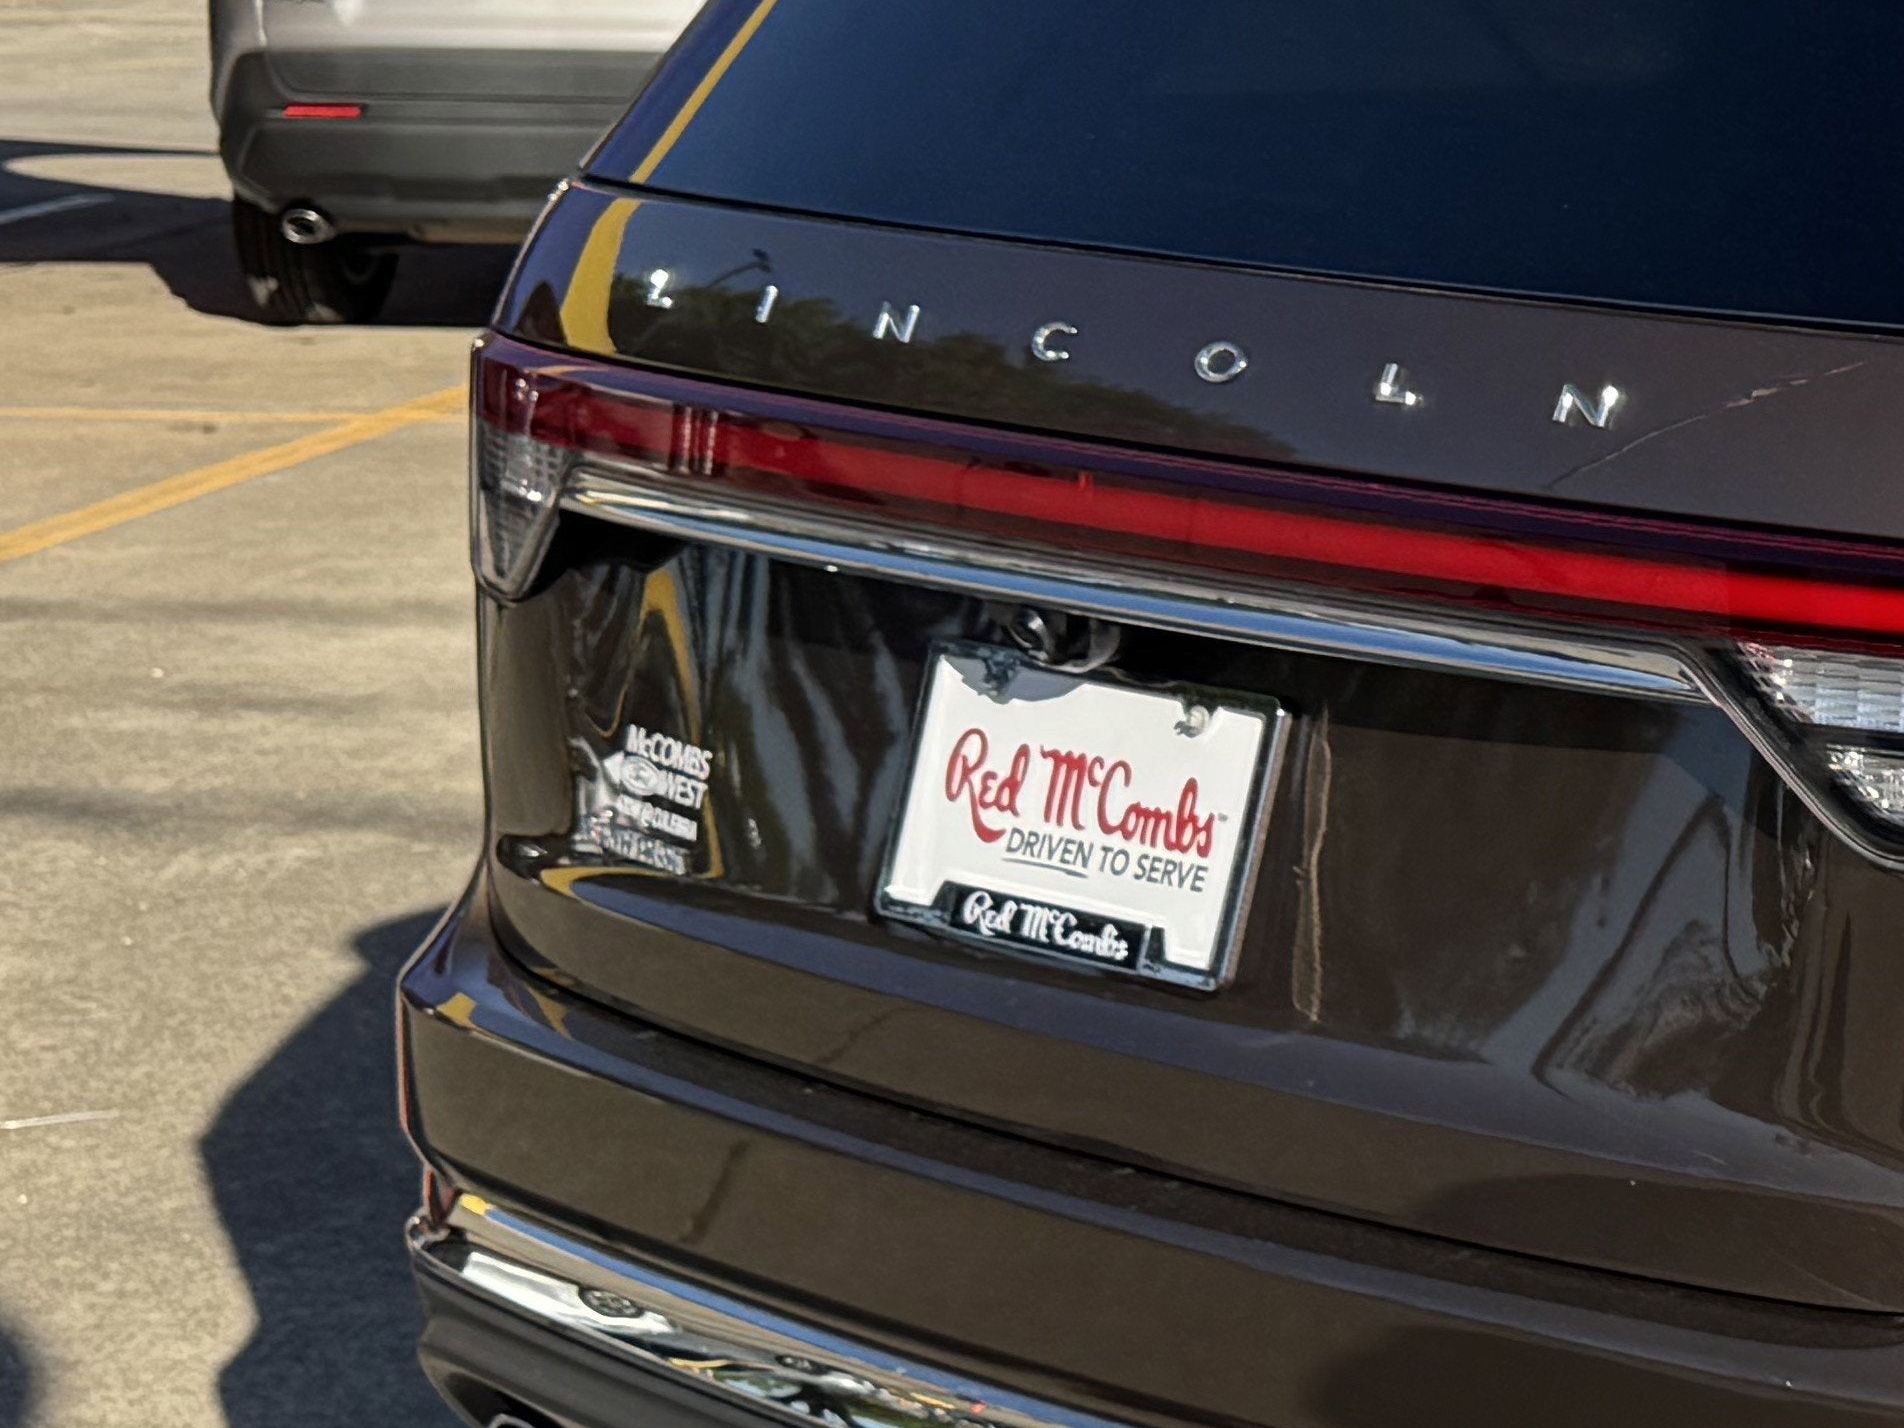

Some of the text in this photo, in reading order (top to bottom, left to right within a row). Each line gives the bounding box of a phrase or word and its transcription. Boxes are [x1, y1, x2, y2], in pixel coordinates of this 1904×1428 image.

[645, 268, 1621, 429] LINCOLN
[945, 728, 1217, 858] Red McCombs
[1005, 827, 1209, 893] DRIVEN TO SERVE
[963, 889, 1129, 961] Red McCombs
